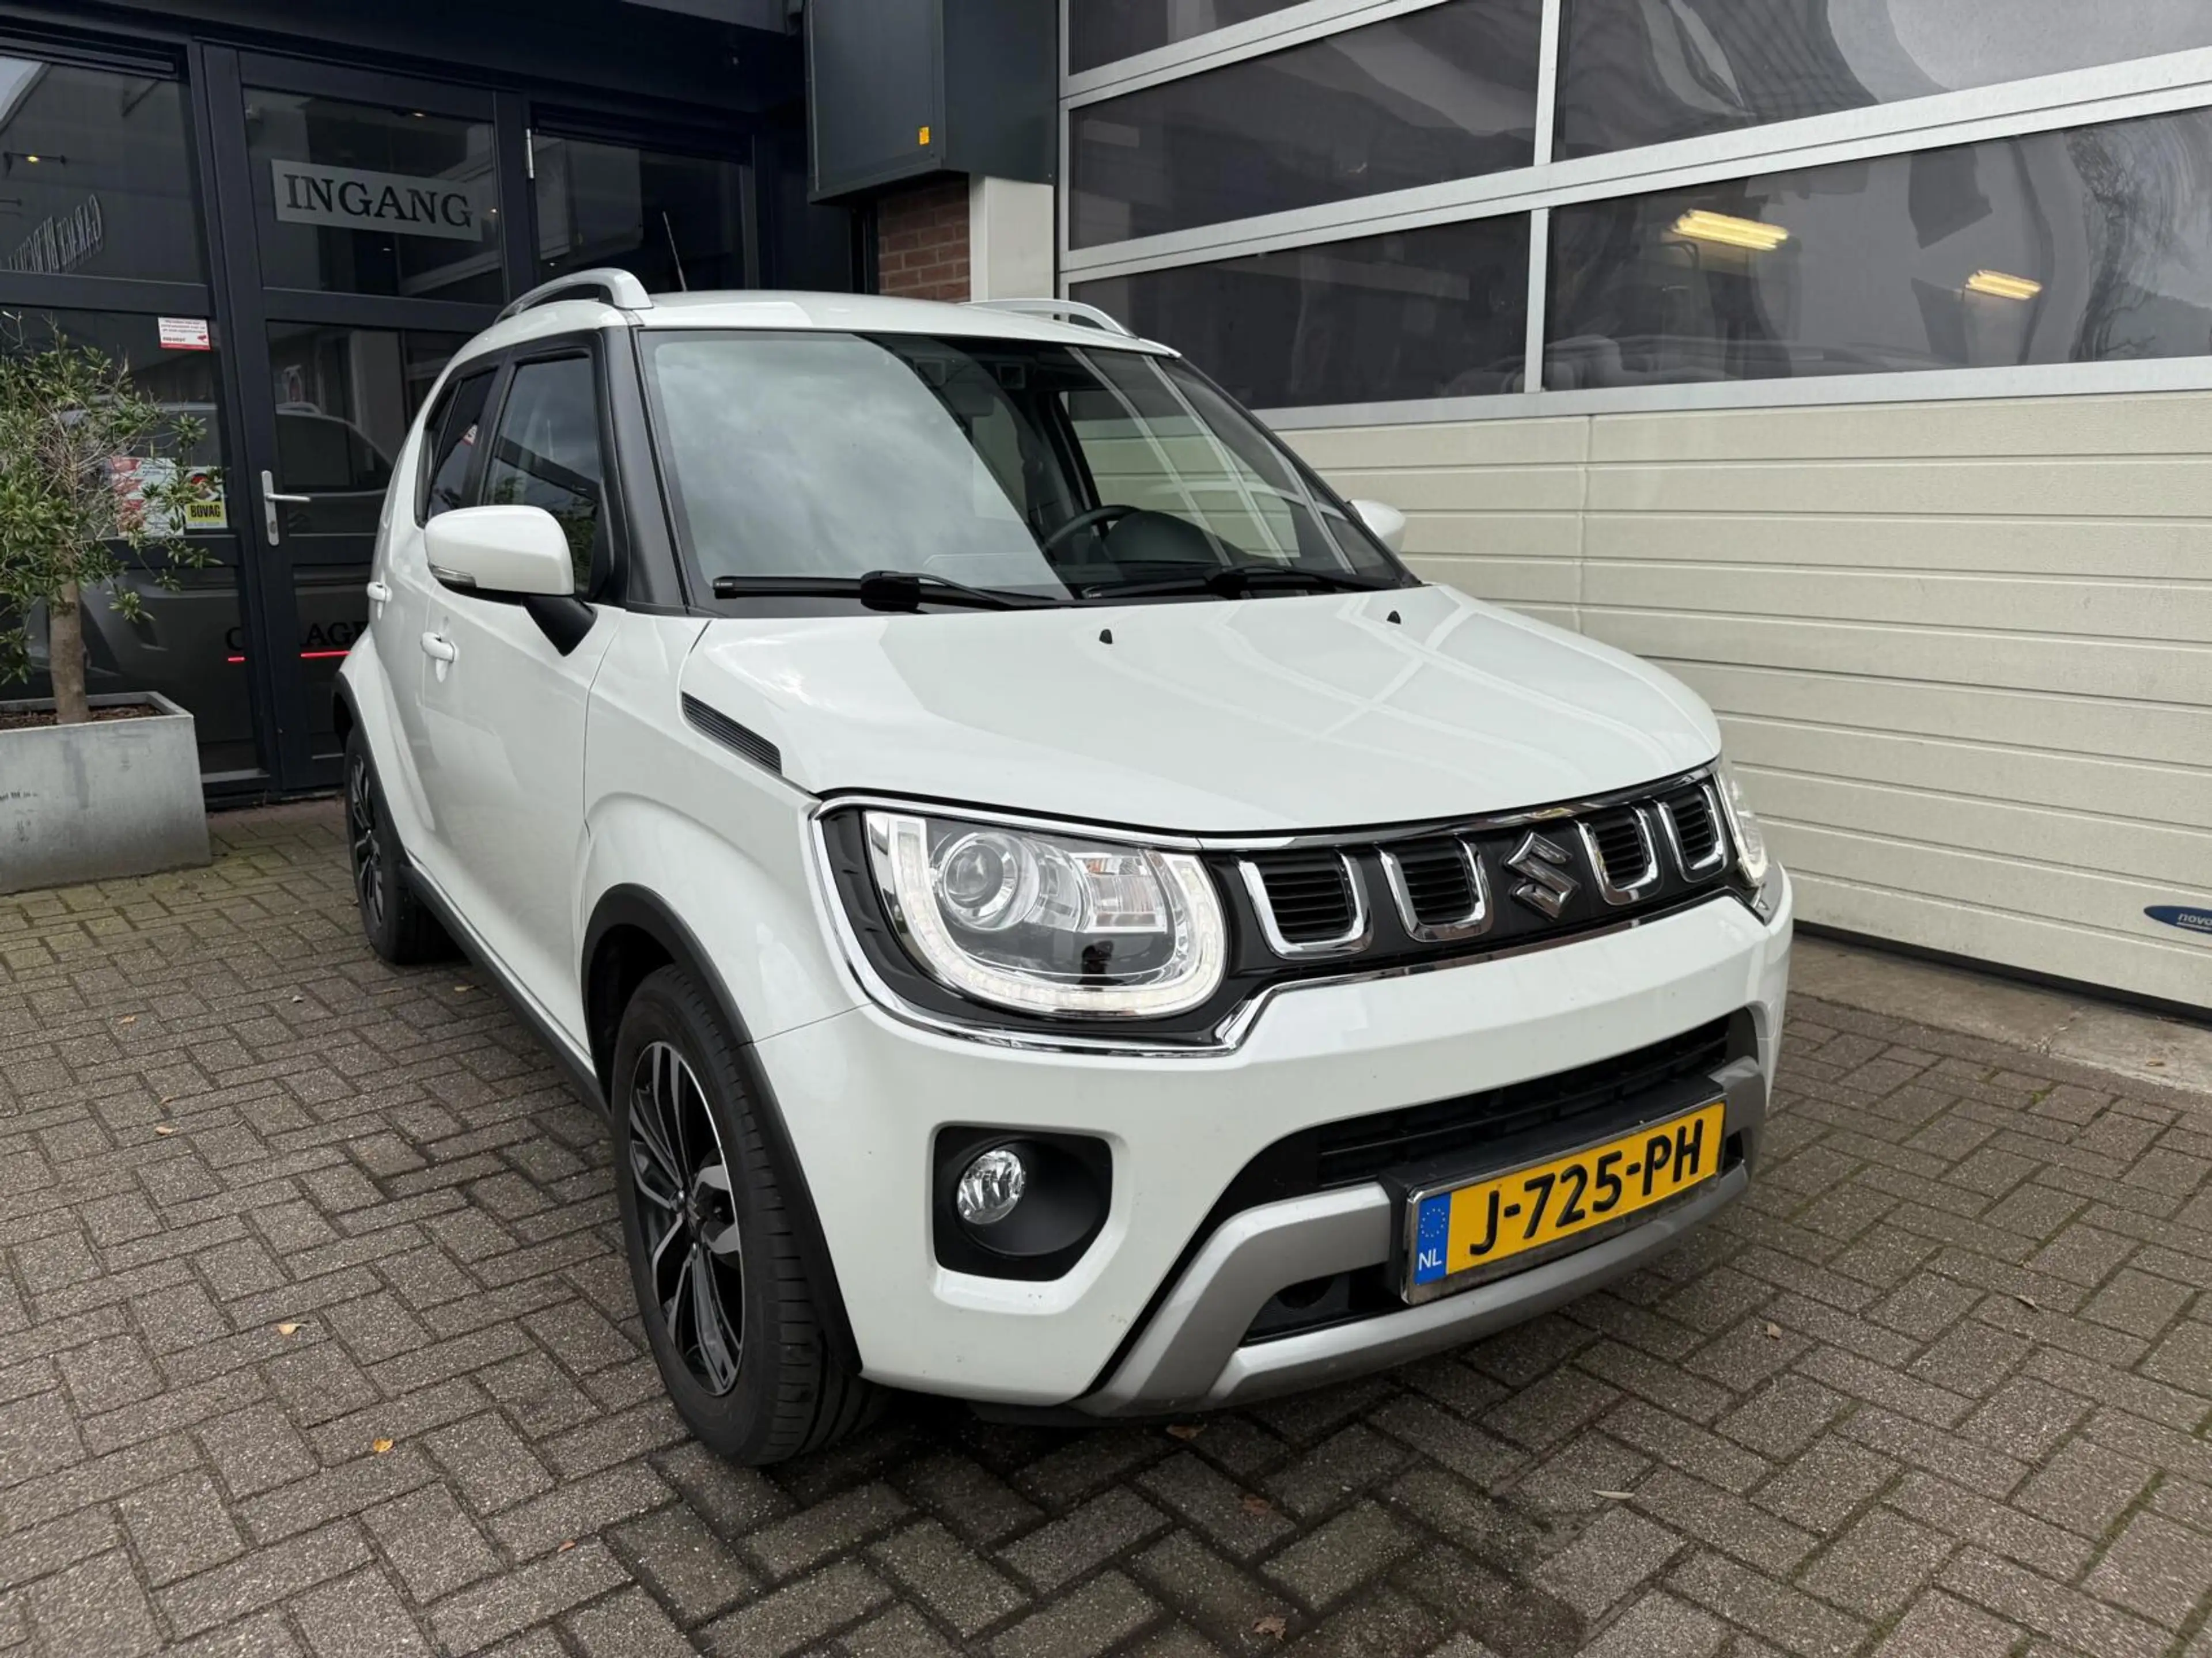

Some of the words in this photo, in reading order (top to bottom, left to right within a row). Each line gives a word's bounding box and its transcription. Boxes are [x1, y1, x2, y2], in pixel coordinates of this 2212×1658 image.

[283, 173, 472, 228] INGANG
[190, 504, 221, 518] BOVAG
[1469, 1119, 1703, 1256] J-725-PH
[1418, 1249, 1442, 1271] NL
